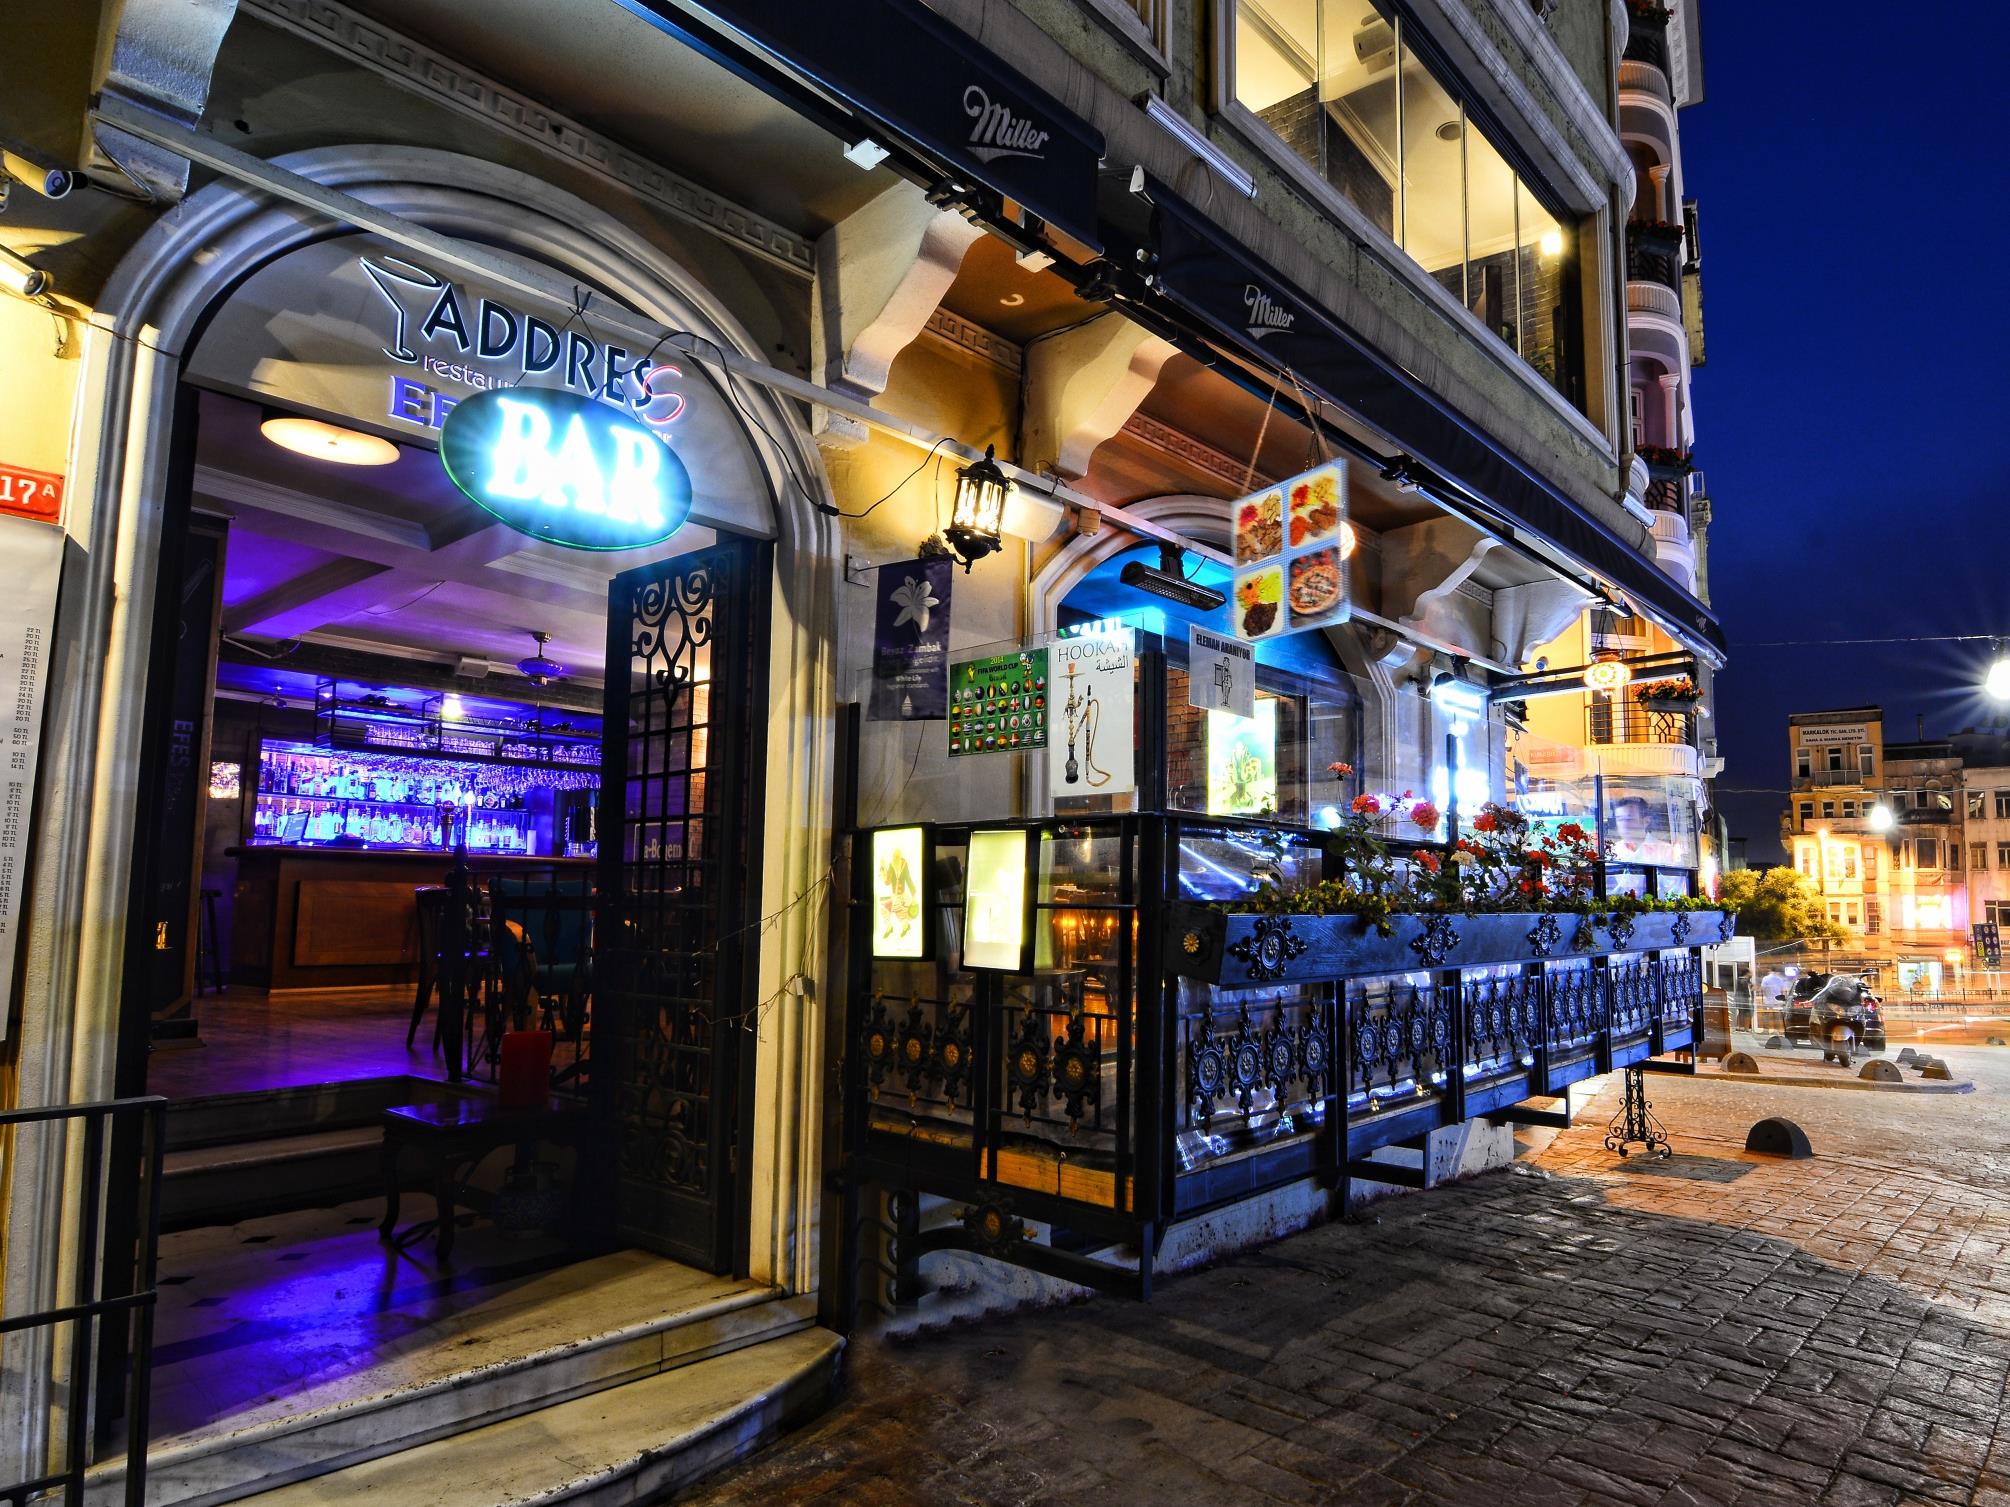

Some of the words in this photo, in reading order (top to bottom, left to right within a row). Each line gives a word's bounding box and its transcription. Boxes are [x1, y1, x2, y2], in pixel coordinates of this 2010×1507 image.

[963, 85, 1050, 150] Miller
[1244, 284, 1295, 328] Miller
[486, 397, 666, 530] BAR
[1196, 633, 1220, 651] ELEMAN
[977, 667, 989, 675] FIFA
[989, 664, 1008, 672] WORLD
[990, 656, 1004, 665] 2014
[1095, 654, 1129, 674] الشيشة
